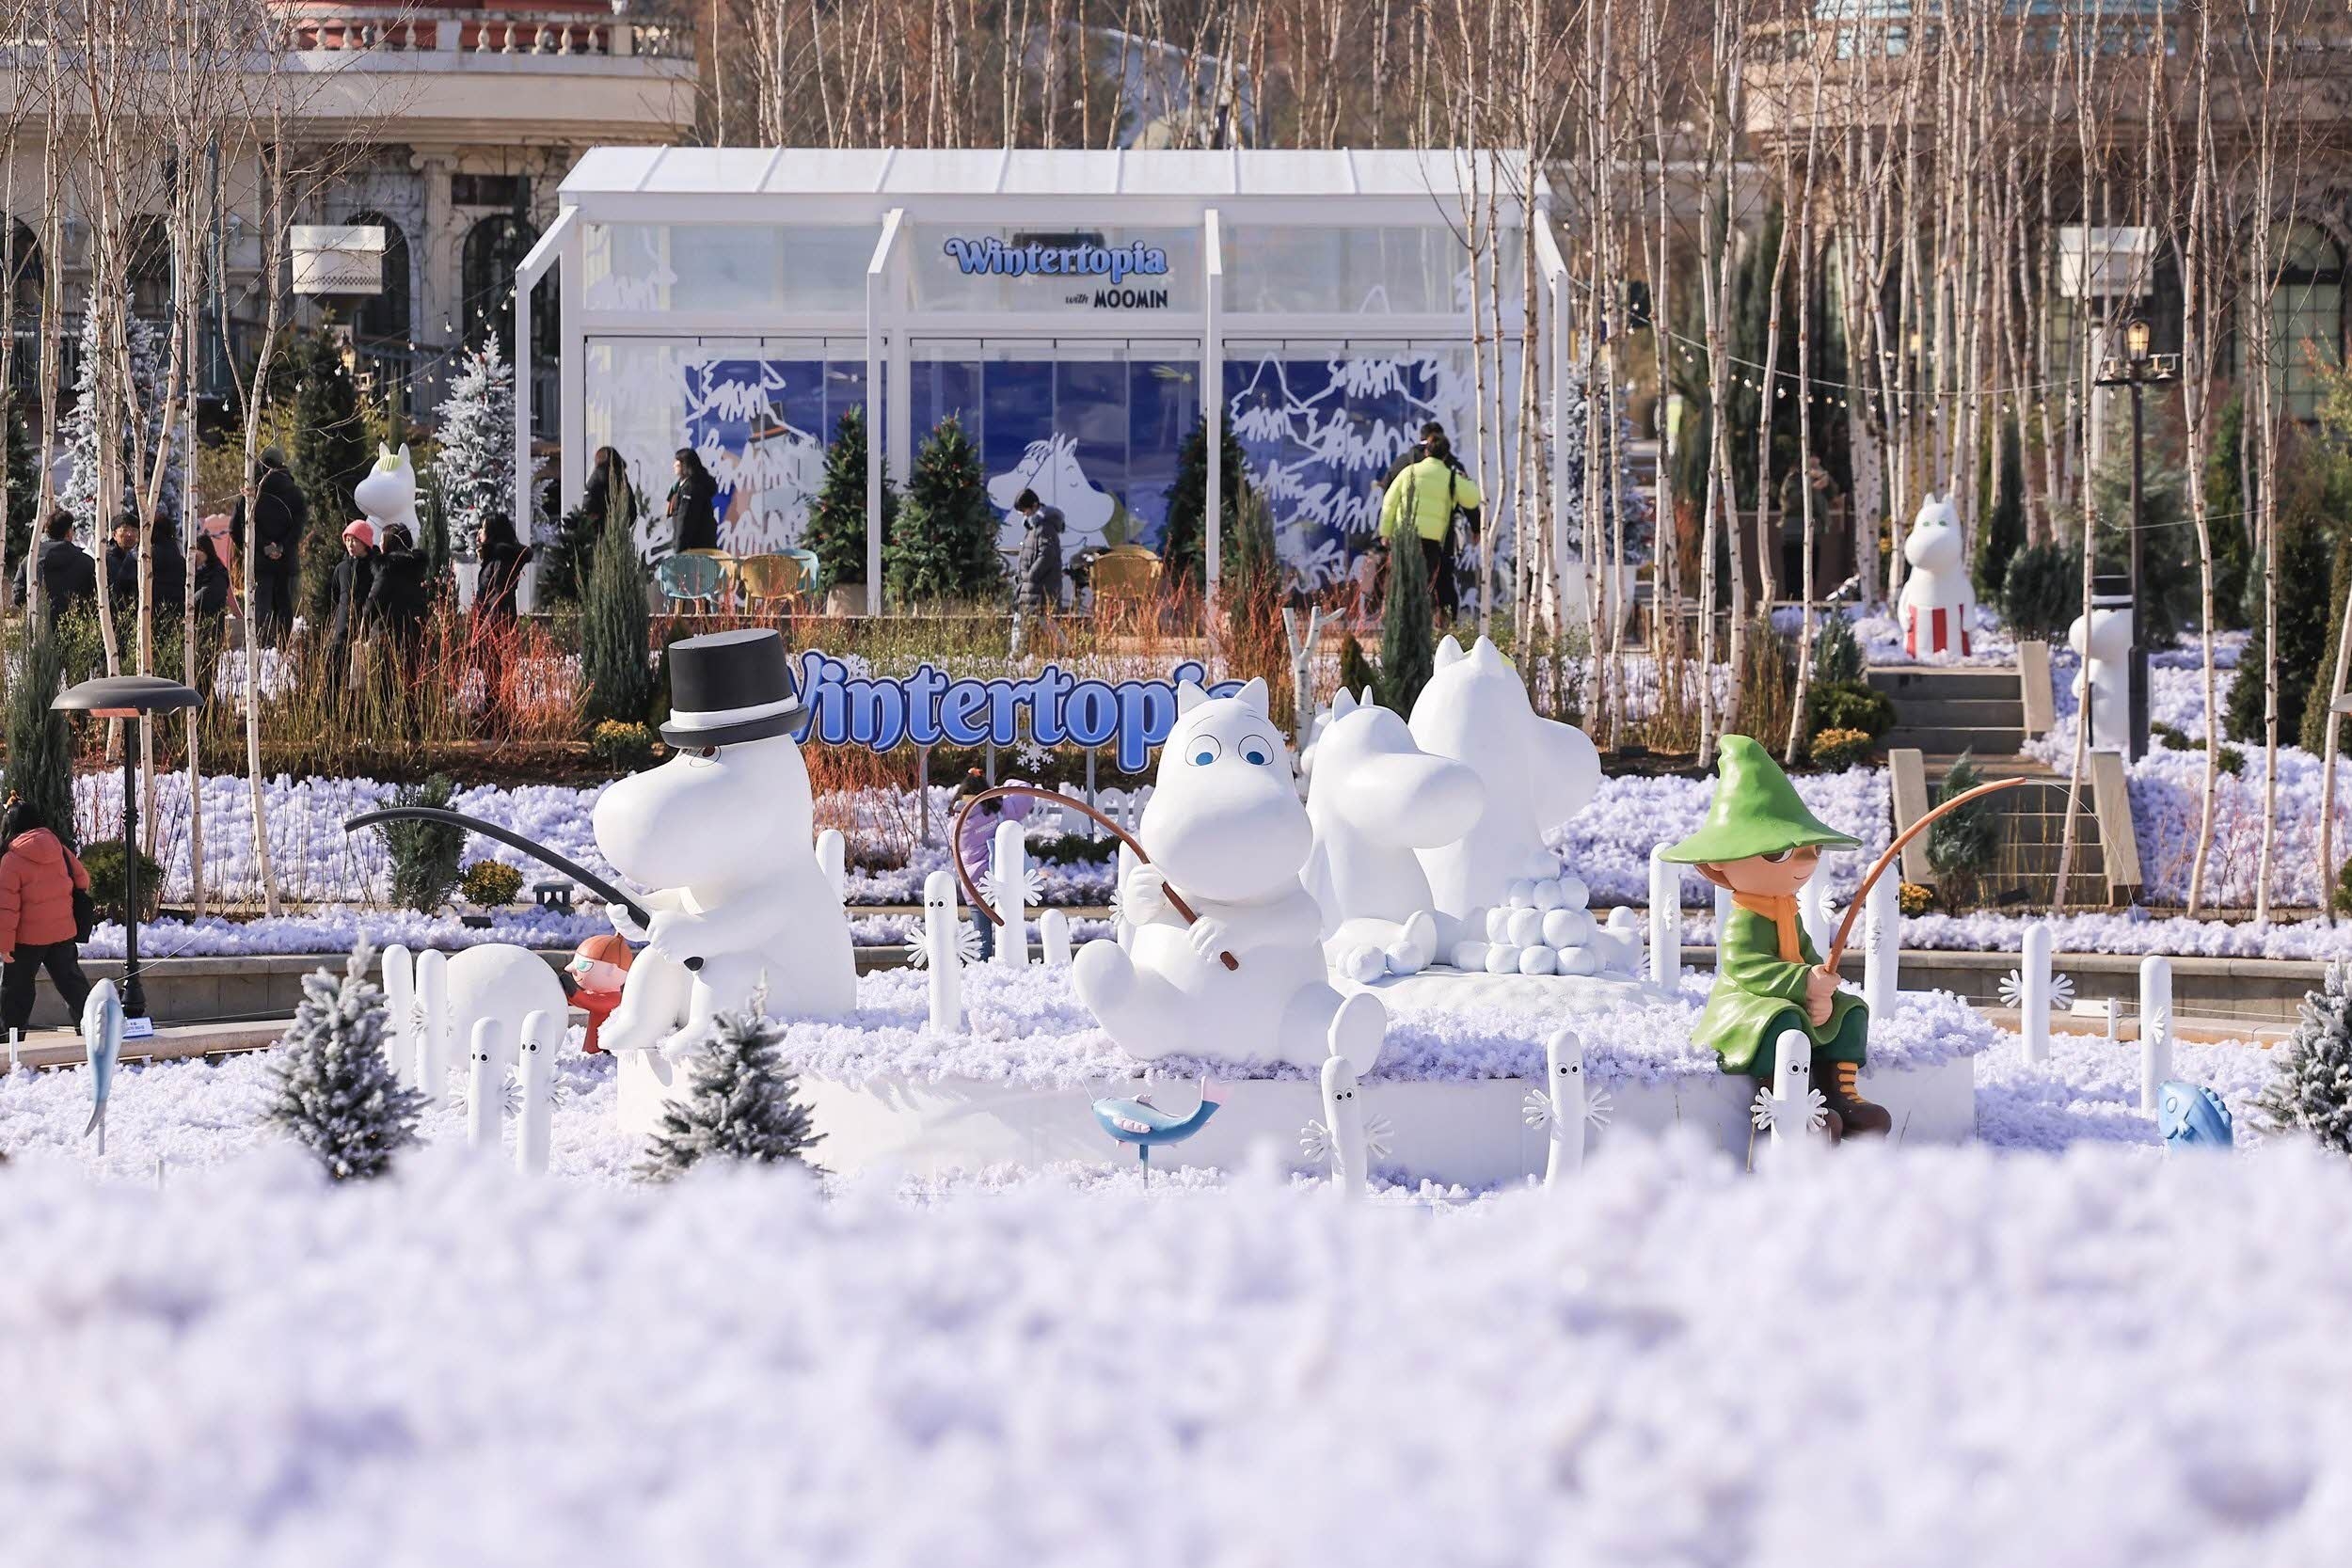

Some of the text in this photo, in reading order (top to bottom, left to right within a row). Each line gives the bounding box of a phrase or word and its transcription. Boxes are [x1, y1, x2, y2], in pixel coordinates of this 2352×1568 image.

[945, 237, 1168, 284] Wintertopia
[1065, 289, 1168, 309] with MOOMIN
[787, 649, 1248, 773] intertop
